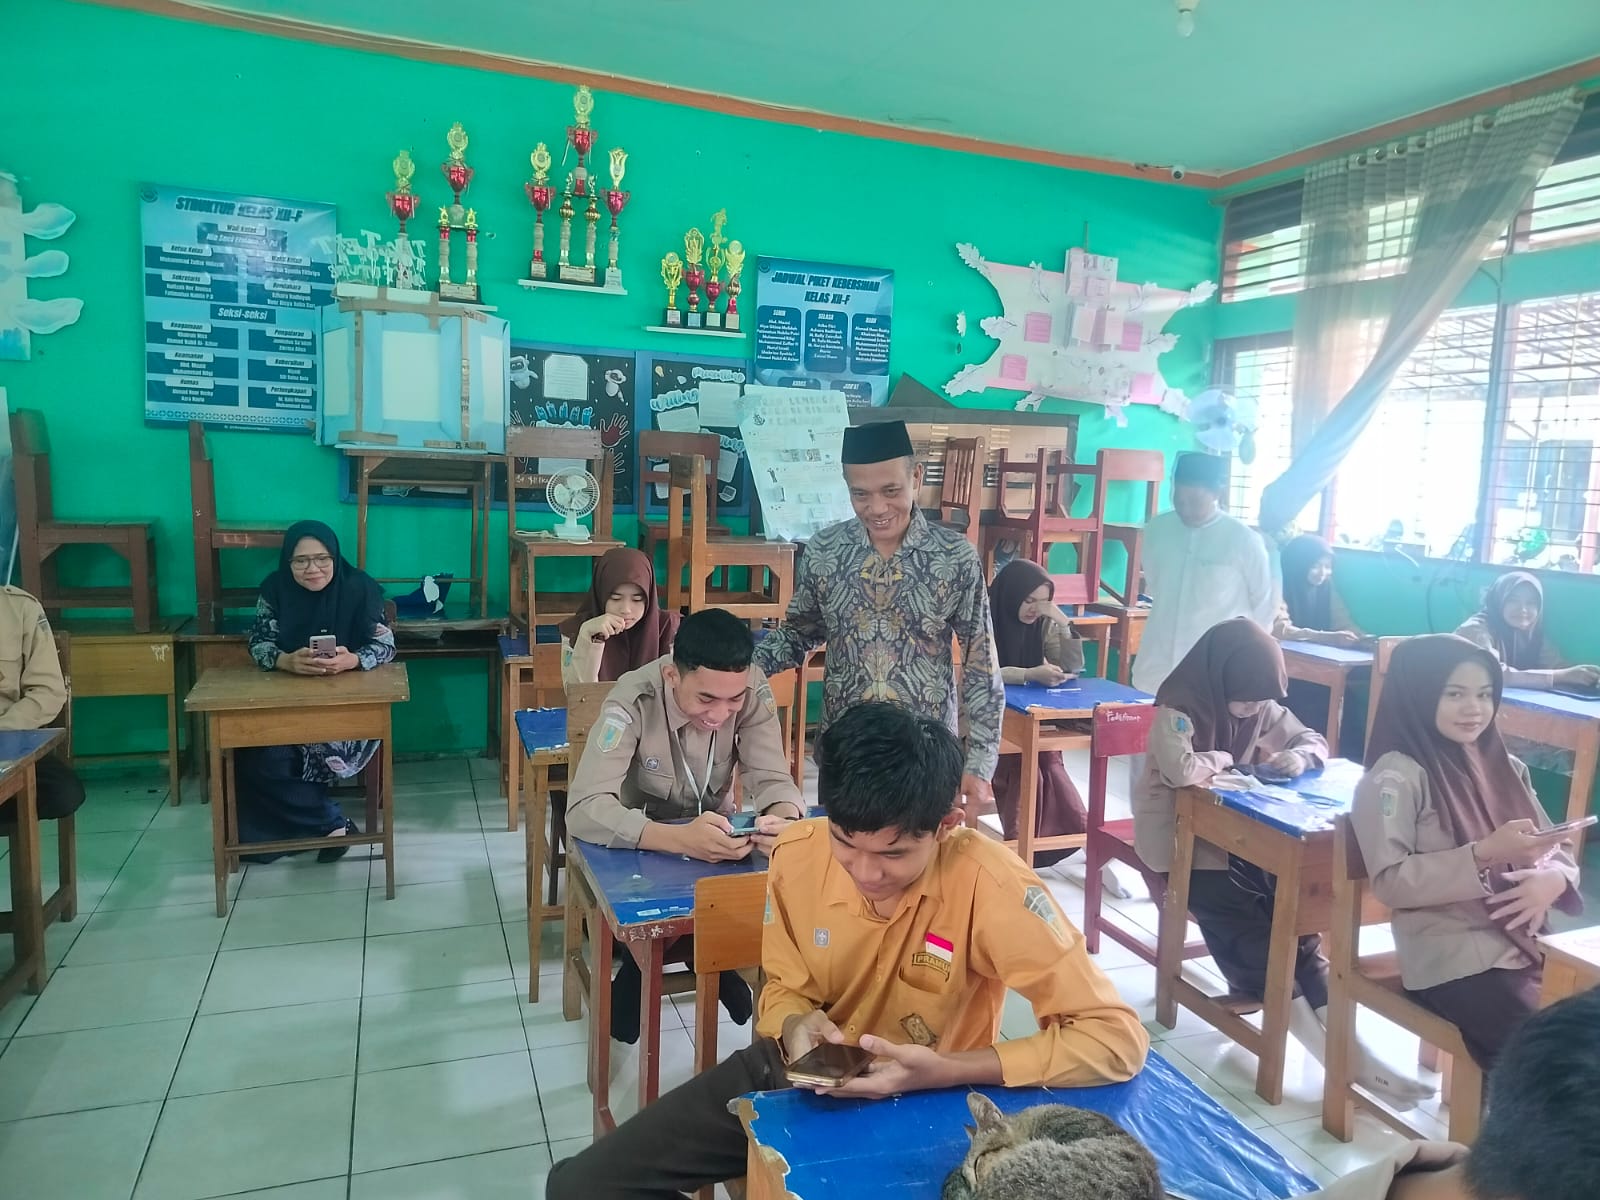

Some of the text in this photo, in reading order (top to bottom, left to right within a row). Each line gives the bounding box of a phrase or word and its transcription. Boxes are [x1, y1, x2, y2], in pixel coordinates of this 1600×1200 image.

[175, 197, 304, 222] STRUKTUR KELAS XII-F
[172, 274, 201, 282] Sekretaris
[772, 272, 881, 292] JADWAL PIKET KEBERSIHAN
[273, 282, 301, 290] Bendahara
[804, 291, 851, 305] KELAS XII-F
[218, 307, 267, 320] Seksi-seksi
[171, 322, 203, 330] Keagamaan
